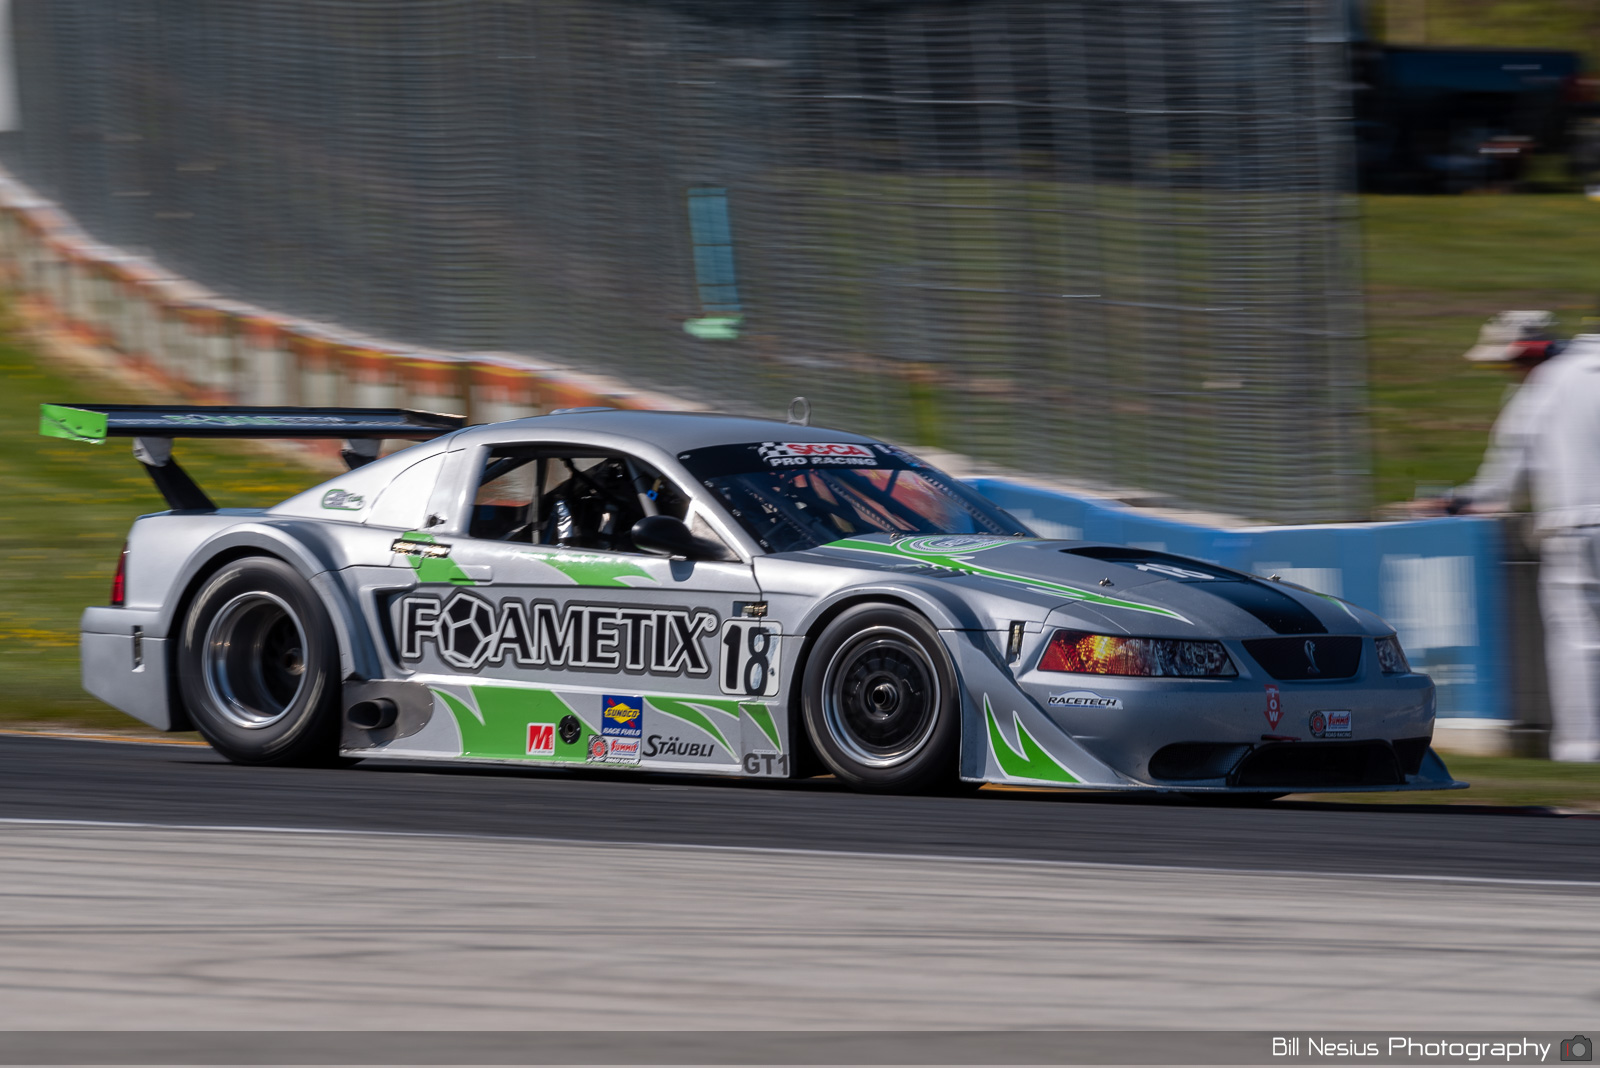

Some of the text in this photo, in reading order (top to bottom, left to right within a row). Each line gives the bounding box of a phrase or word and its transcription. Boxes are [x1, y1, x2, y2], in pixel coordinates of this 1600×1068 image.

[786, 443, 870, 456] SCCA
[769, 456, 878, 466] PRO RACING
[723, 624, 770, 696] 18
[1048, 697, 1117, 706] RACETECH
[1266, 688, 1280, 722] TOW
[605, 708, 639, 718] SUNOCO
[621, 728, 641, 736] FUELS
[643, 734, 715, 758] STÄUBLI
[743, 752, 788, 776] GT1
